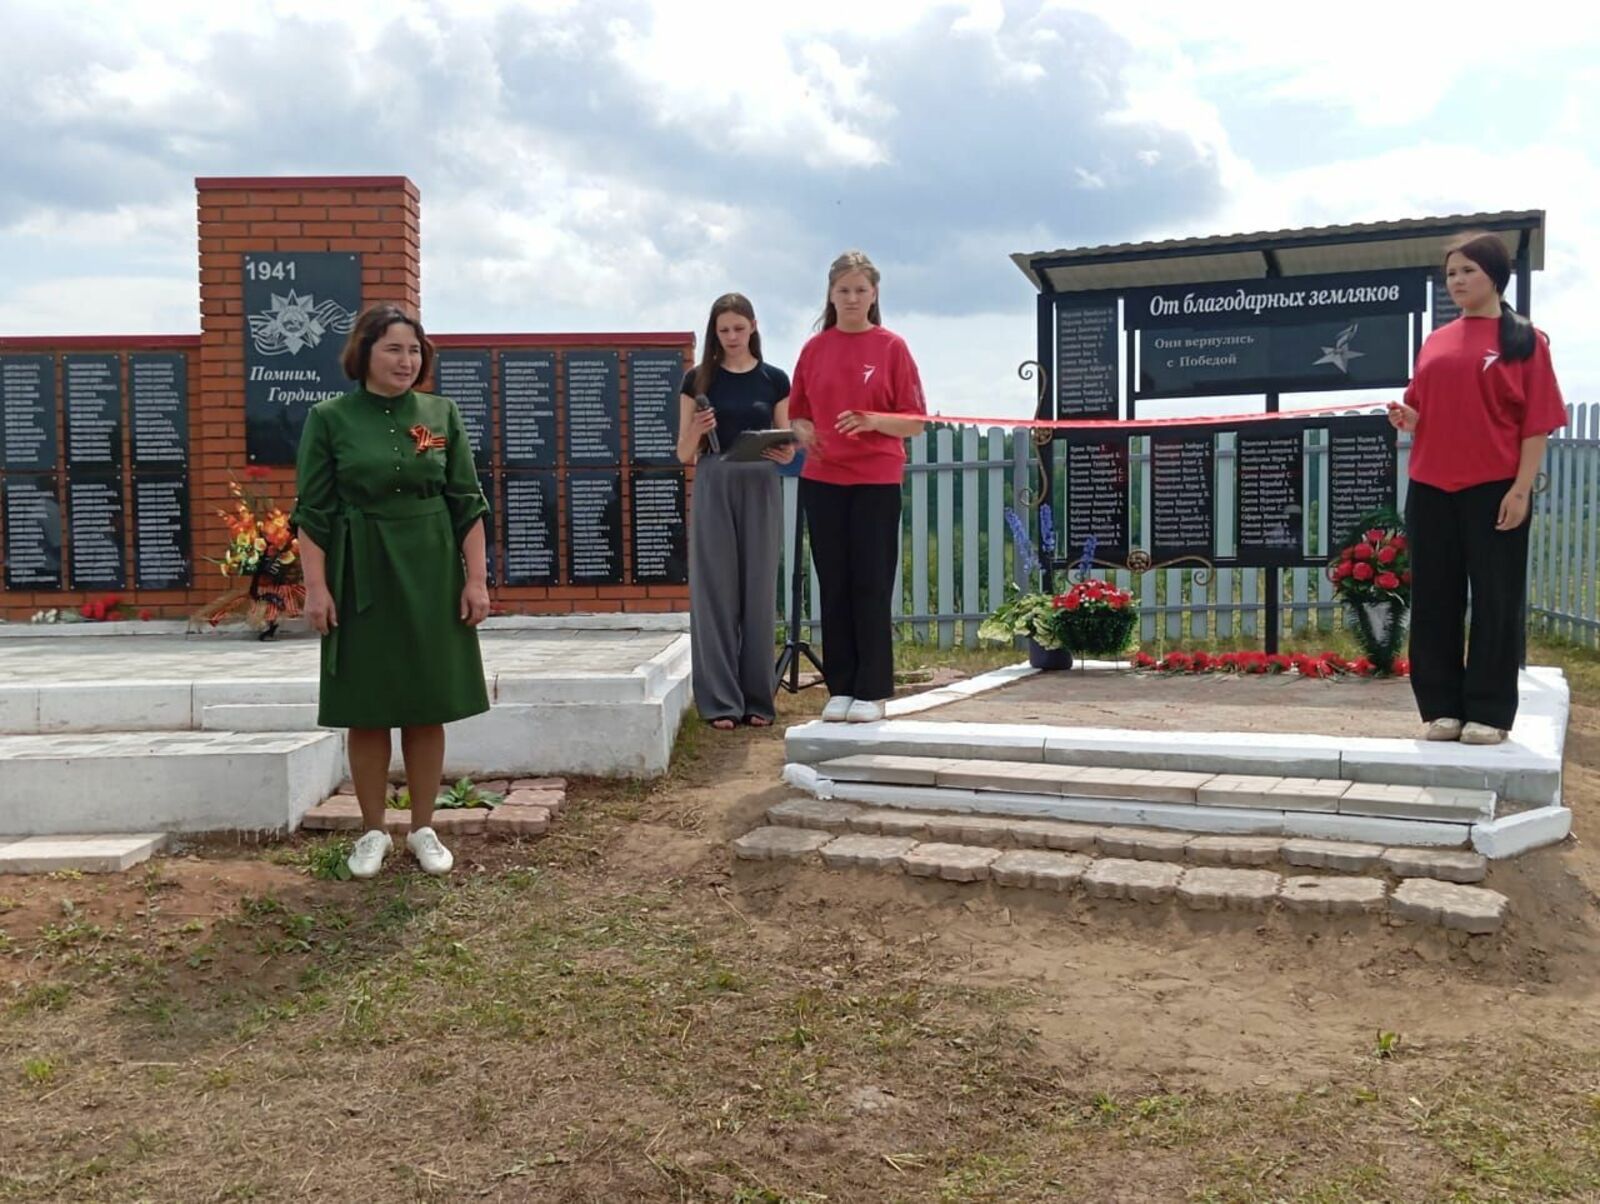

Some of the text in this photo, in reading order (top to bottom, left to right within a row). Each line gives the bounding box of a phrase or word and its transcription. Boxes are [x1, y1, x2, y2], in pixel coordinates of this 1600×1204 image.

[246, 261, 297, 281] 1941
[1150, 285, 1400, 316] От благодарных земляков
[1154, 335, 1255, 349] Они вернулись
[1166, 353, 1238, 368] с Победой
[250, 366, 321, 383] Помним,
